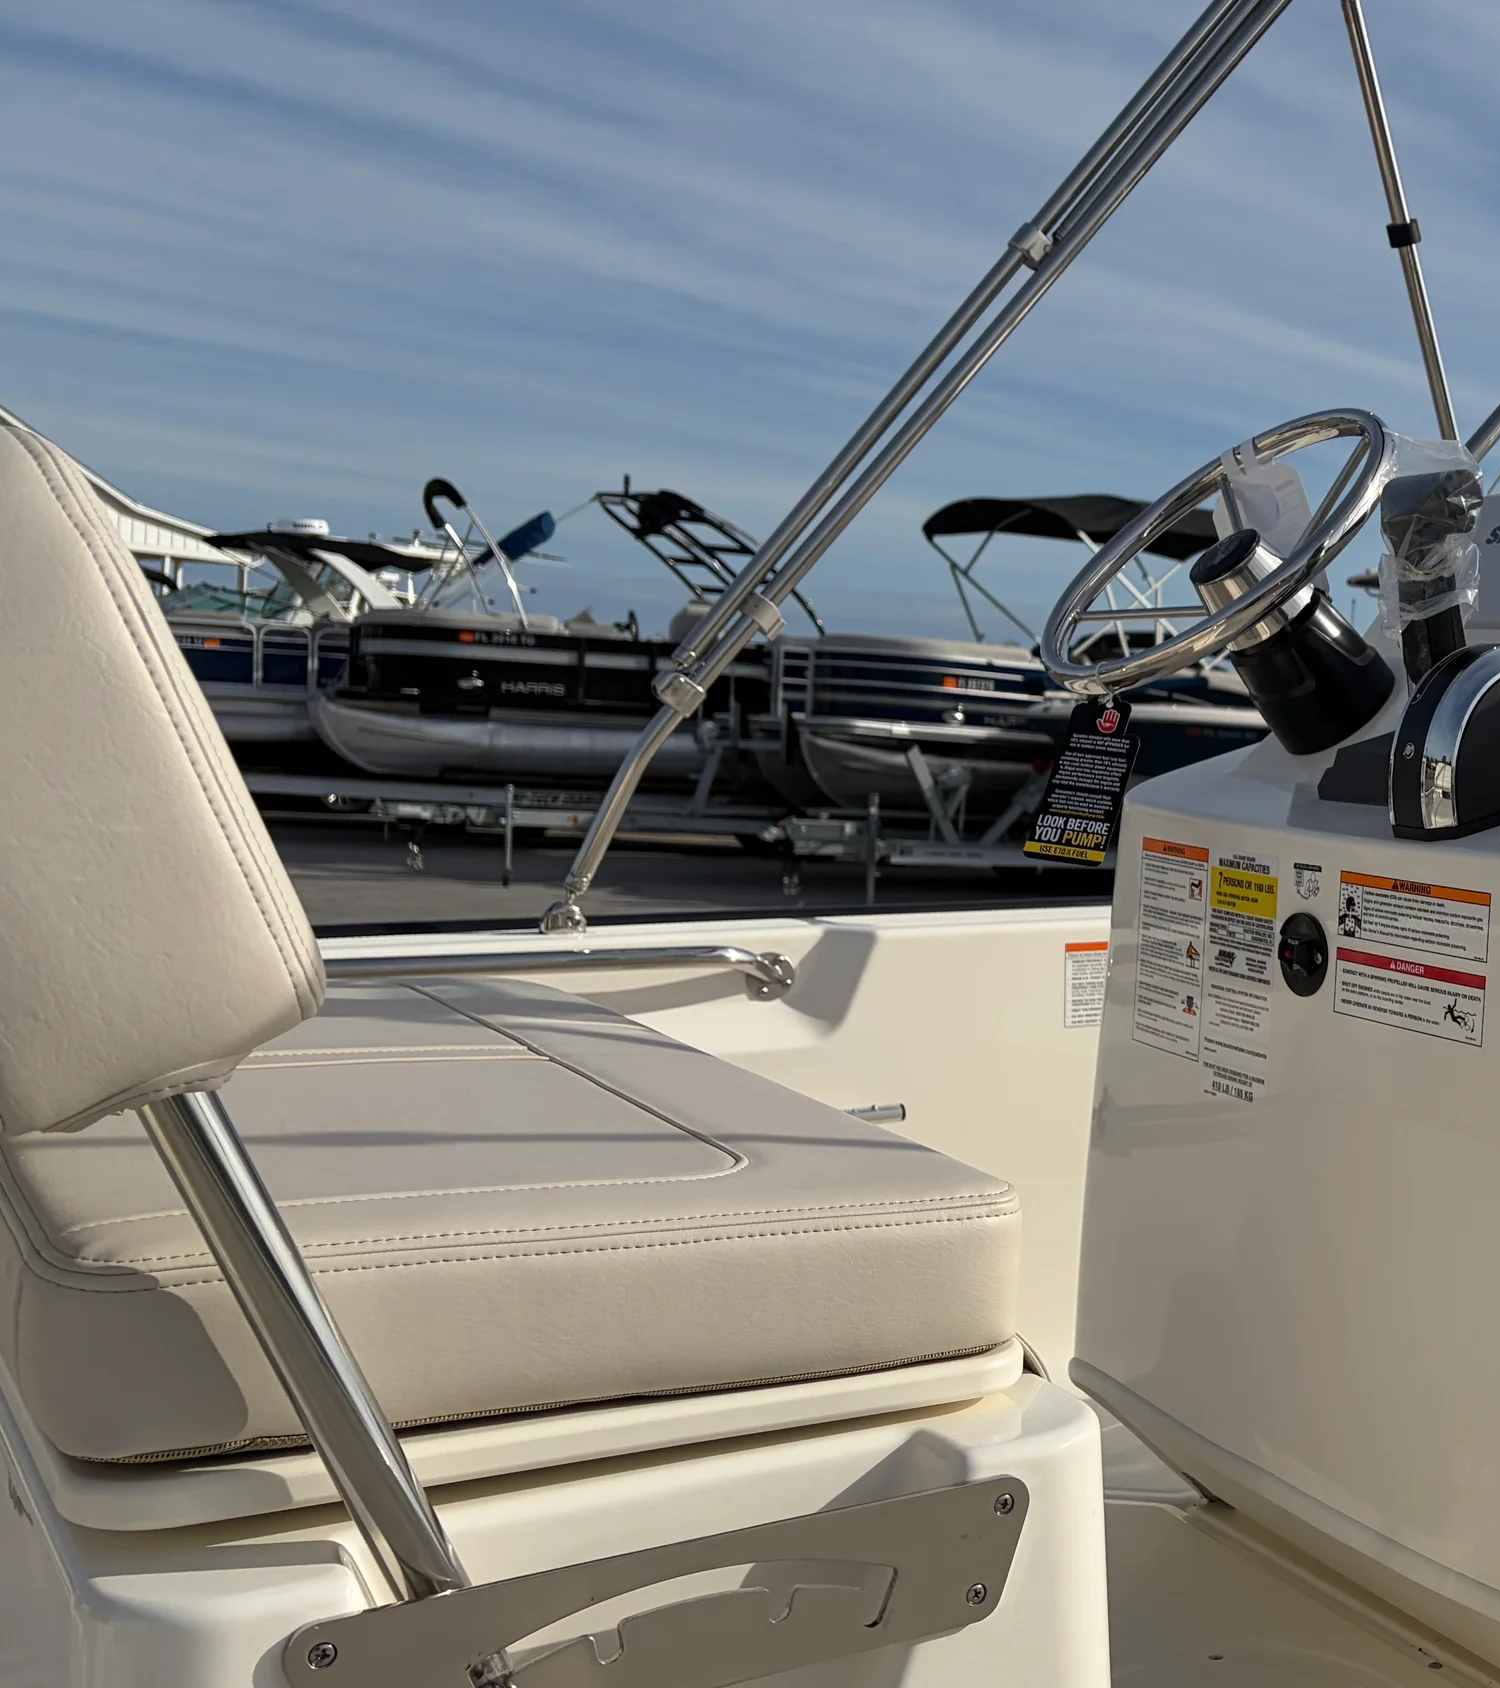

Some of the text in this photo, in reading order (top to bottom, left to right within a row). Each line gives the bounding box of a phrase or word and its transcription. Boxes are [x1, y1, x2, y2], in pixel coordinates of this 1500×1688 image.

[501, 681, 566, 697] HARRIS
[1037, 814, 1110, 835] LOOK BEFORE
[1034, 826, 1107, 849] YOU PUMP!
[1040, 845, 1052, 853] USE
[1071, 850, 1089, 858] FUEL
[1219, 858, 1240, 870] MAXIMUM
[1242, 862, 1270, 875] CAPACITIES
[1218, 872, 1223, 888] 7
[1222, 876, 1244, 889] PERSONS
[1245, 880, 1252, 890] OR
[1264, 884, 1275, 894] LBS.
[1400, 881, 1431, 895] WARNING
[1396, 961, 1424, 975] DANGER
[1222, 1084, 1230, 1094] LB
[1244, 1090, 1253, 1102] KG
